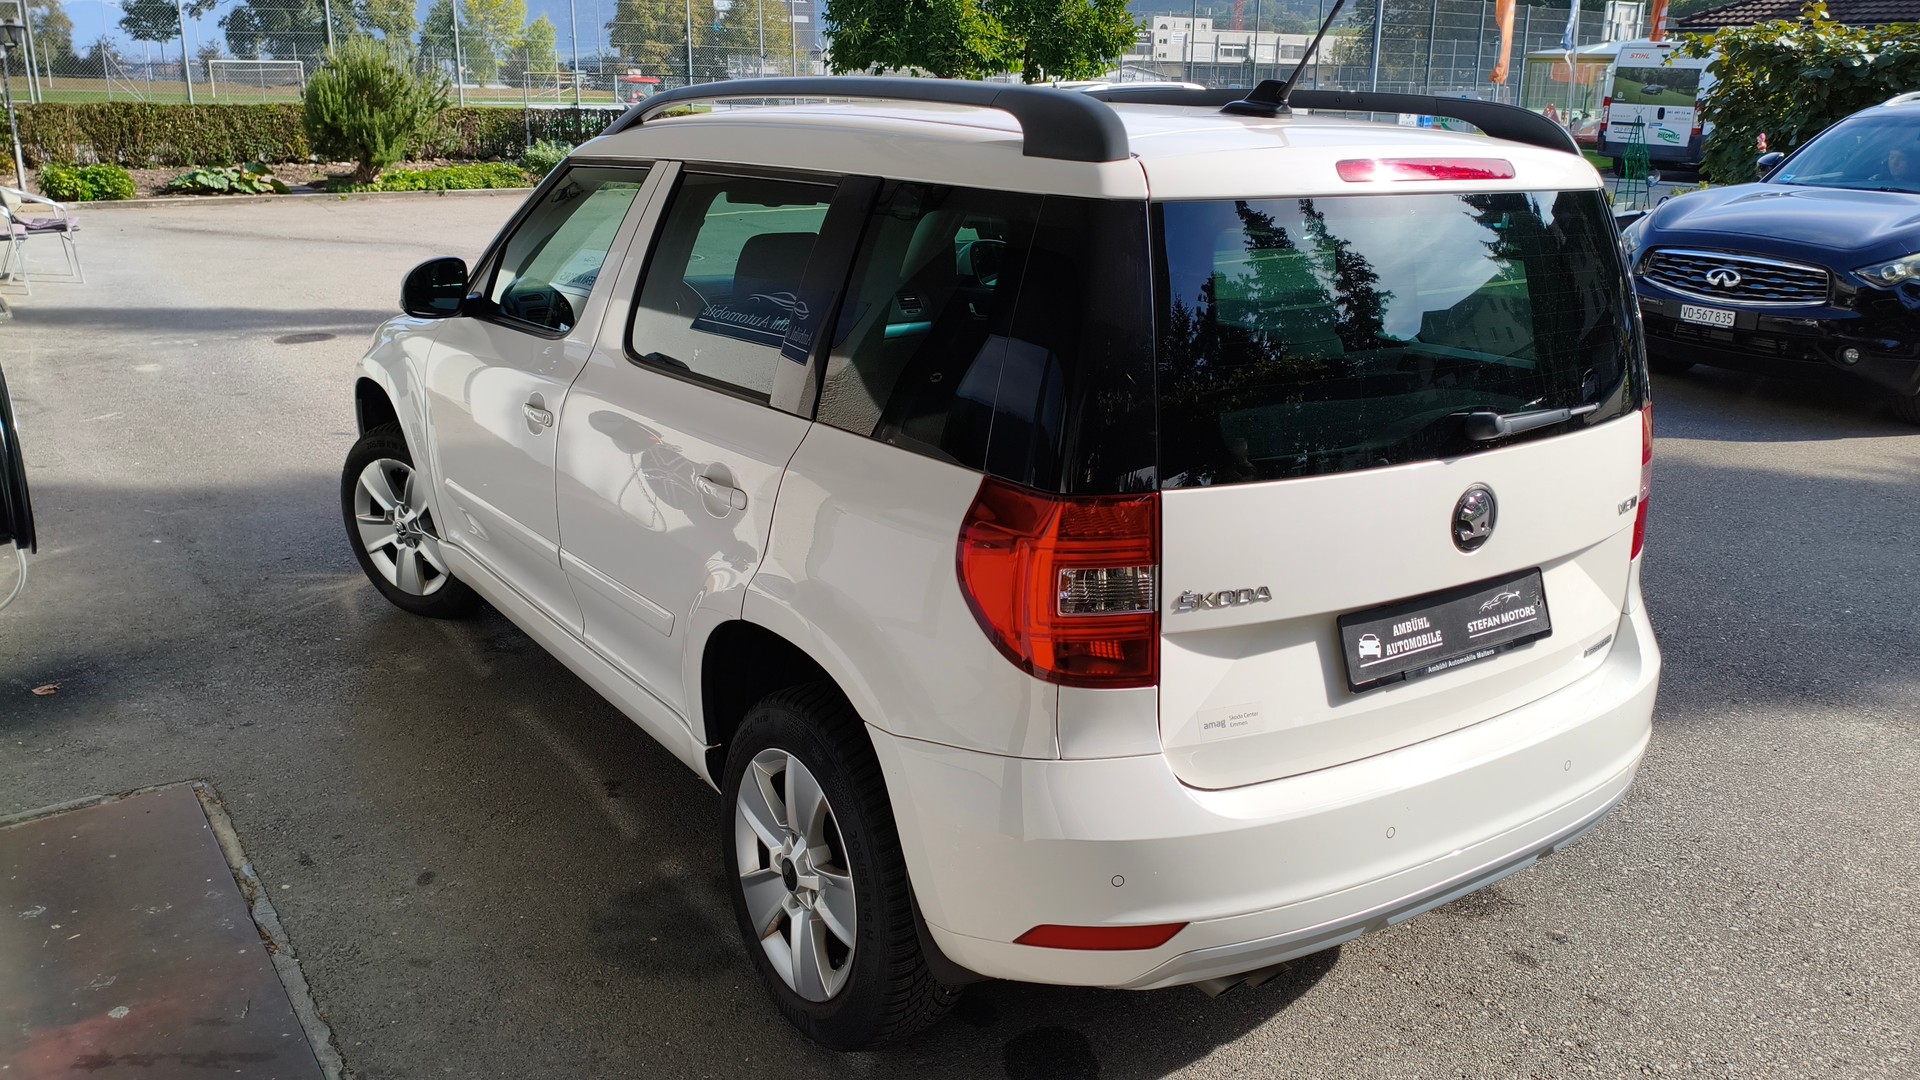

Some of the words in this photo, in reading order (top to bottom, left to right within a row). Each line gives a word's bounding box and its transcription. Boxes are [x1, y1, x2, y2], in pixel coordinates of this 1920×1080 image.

[1630, 52, 1650, 60] STIHL
[1178, 586, 1273, 610] ŠKODA
[1393, 616, 1430, 636] AMBÜHL
[1467, 614, 1501, 633] STEFAN
[1502, 605, 1536, 624] MOTORS
[1386, 630, 1443, 656] AUTOMOBILE
[1448, 655, 1477, 667] Automobile
[1203, 719, 1227, 730] amag
